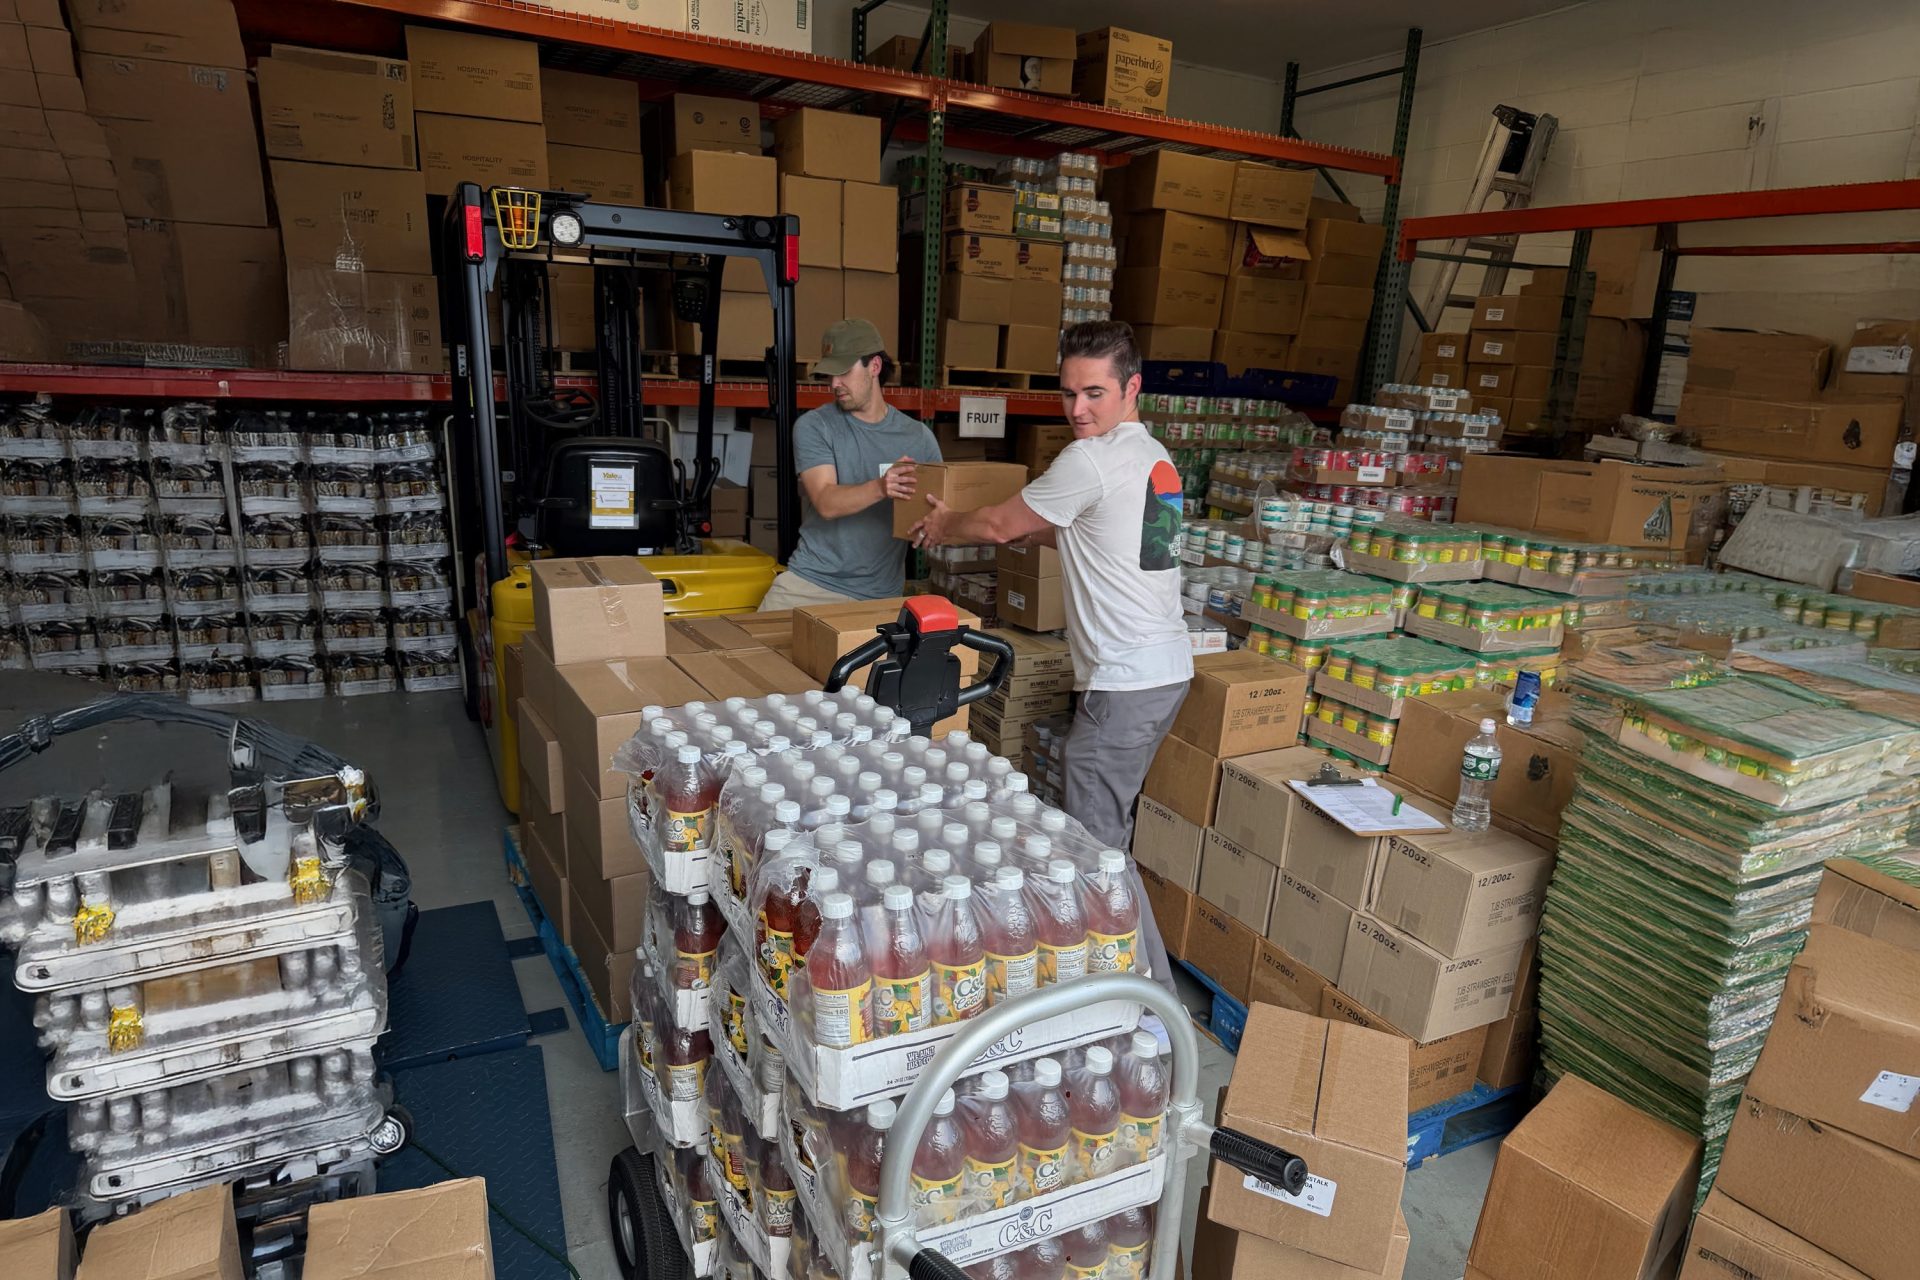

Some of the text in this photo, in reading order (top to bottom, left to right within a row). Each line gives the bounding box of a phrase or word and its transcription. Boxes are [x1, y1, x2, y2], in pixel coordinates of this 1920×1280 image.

[692, 18, 699, 31] 30
[457, 65, 499, 76] HOSPITALITY
[1115, 54, 1155, 71] paperbird
[462, 155, 503, 164] HOSPITALITY
[966, 412, 1000, 424] FRUIT
[1241, 705, 1274, 718] STRAWBERRY
[1274, 703, 1288, 712] JELLY
[1226, 767, 1260, 791] 12/20oz.
[1143, 801, 1175, 824] 12/20oz.
[1210, 834, 1245, 859] 12/20oz.
[1283, 874, 1320, 904] 12/20oz.
[1478, 873, 1515, 888] 12/20oz.
[1198, 907, 1229, 935] 12/20oz.
[1356, 920, 1400, 954] 12/20oz.
[1262, 952, 1299, 984] 12/20oz.
[1445, 958, 1482, 974] 12/20oz.
[1466, 975, 1501, 993] STRAWBERRY
[1416, 1057, 1454, 1077] STRAWBERRY
[1453, 1051, 1471, 1064] JELLY
[999, 1209, 1053, 1249] C&C
